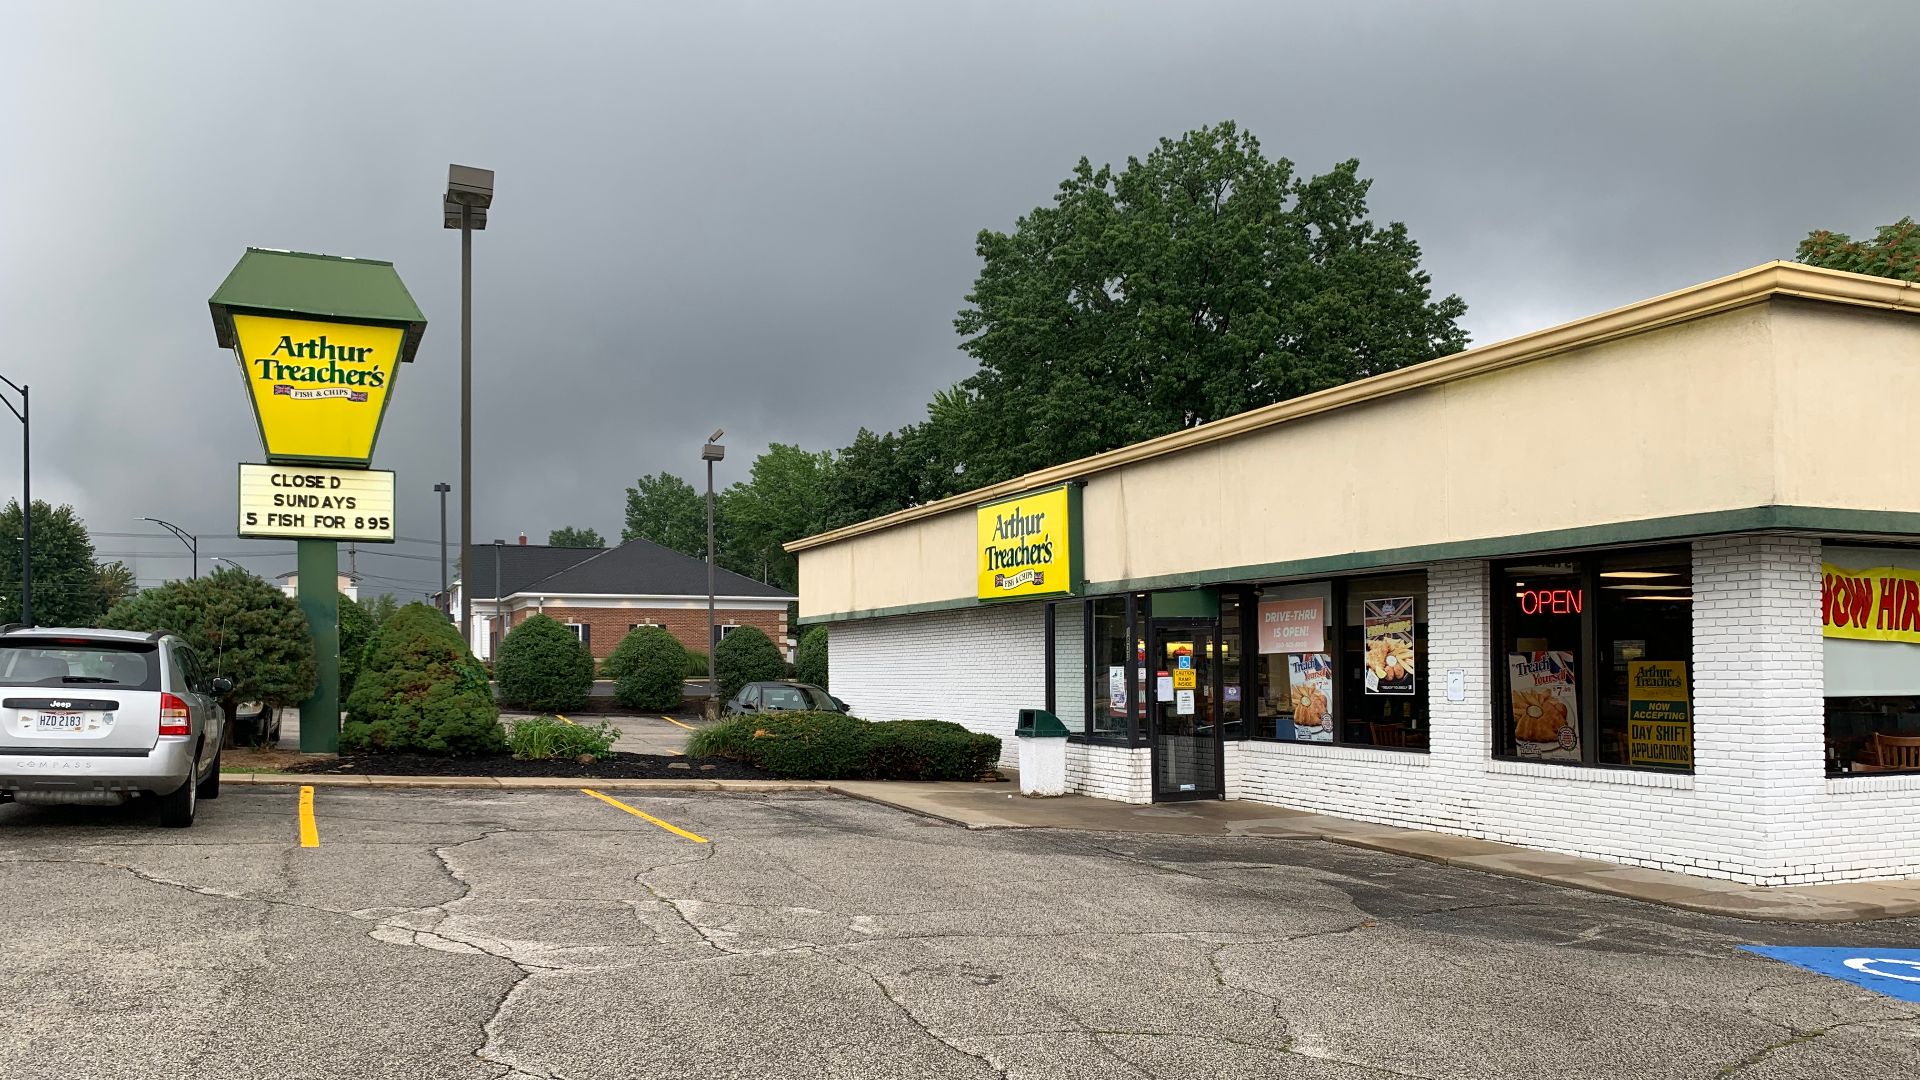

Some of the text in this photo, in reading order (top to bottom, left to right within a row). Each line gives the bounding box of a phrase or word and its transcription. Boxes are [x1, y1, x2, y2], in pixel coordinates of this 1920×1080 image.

[271, 335, 374, 363] Arthur
[254, 359, 385, 388] Treacher's
[294, 388, 349, 398] FISH & CHIPS
[274, 494, 356, 510] SUNDAYS
[246, 512, 258, 526] 5
[267, 513, 305, 528] FISH
[314, 515, 346, 529] FOR
[992, 506, 1045, 541] Arthur
[985, 533, 1053, 571] Treacher's
[1521, 589, 1583, 615] OPEN
[1265, 609, 1317, 623] DRIVE-THRU
[1273, 626, 1309, 638] IS OPEN!
[1637, 665, 1673, 678] Arthur
[50, 700, 71, 709] Jeep
[1648, 702, 1670, 710] NOW
[59, 716, 81, 727] 2183
[1633, 711, 1685, 720] ACCEPTING
[1632, 724, 1687, 742] DAY SHIFT
[1631, 742, 1689, 762] APPLICATIONS
[17, 761, 93, 769] COMPASS
